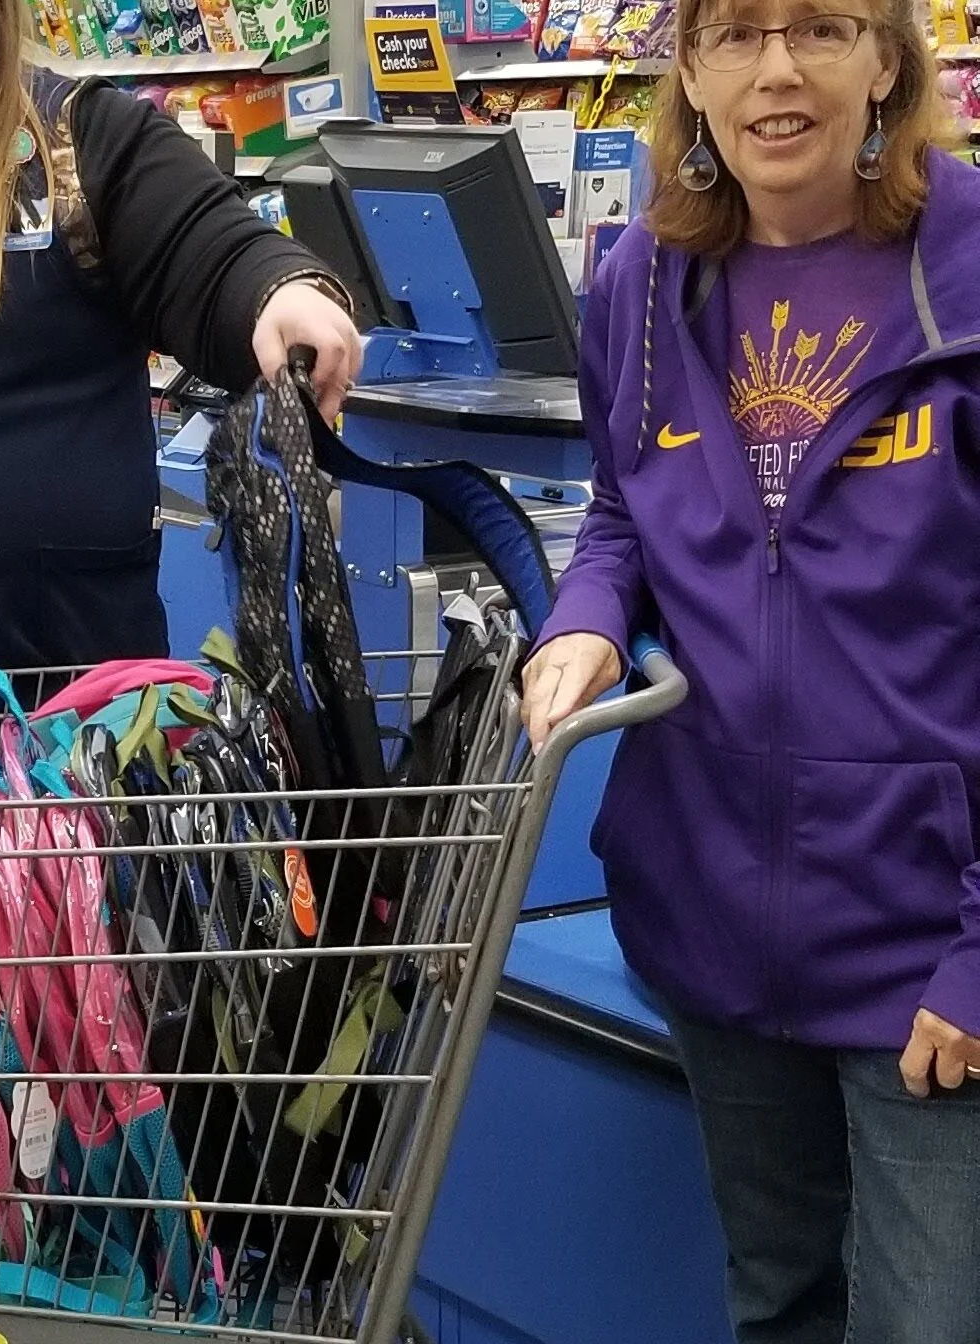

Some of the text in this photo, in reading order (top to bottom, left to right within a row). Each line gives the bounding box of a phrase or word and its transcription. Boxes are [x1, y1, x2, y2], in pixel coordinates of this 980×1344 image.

[377, 35, 428, 56] Cash your
[381, 53, 418, 71] checks
[424, 151, 445, 163] IBM
[841, 404, 931, 468] SU
[749, 443, 782, 476] FIED
